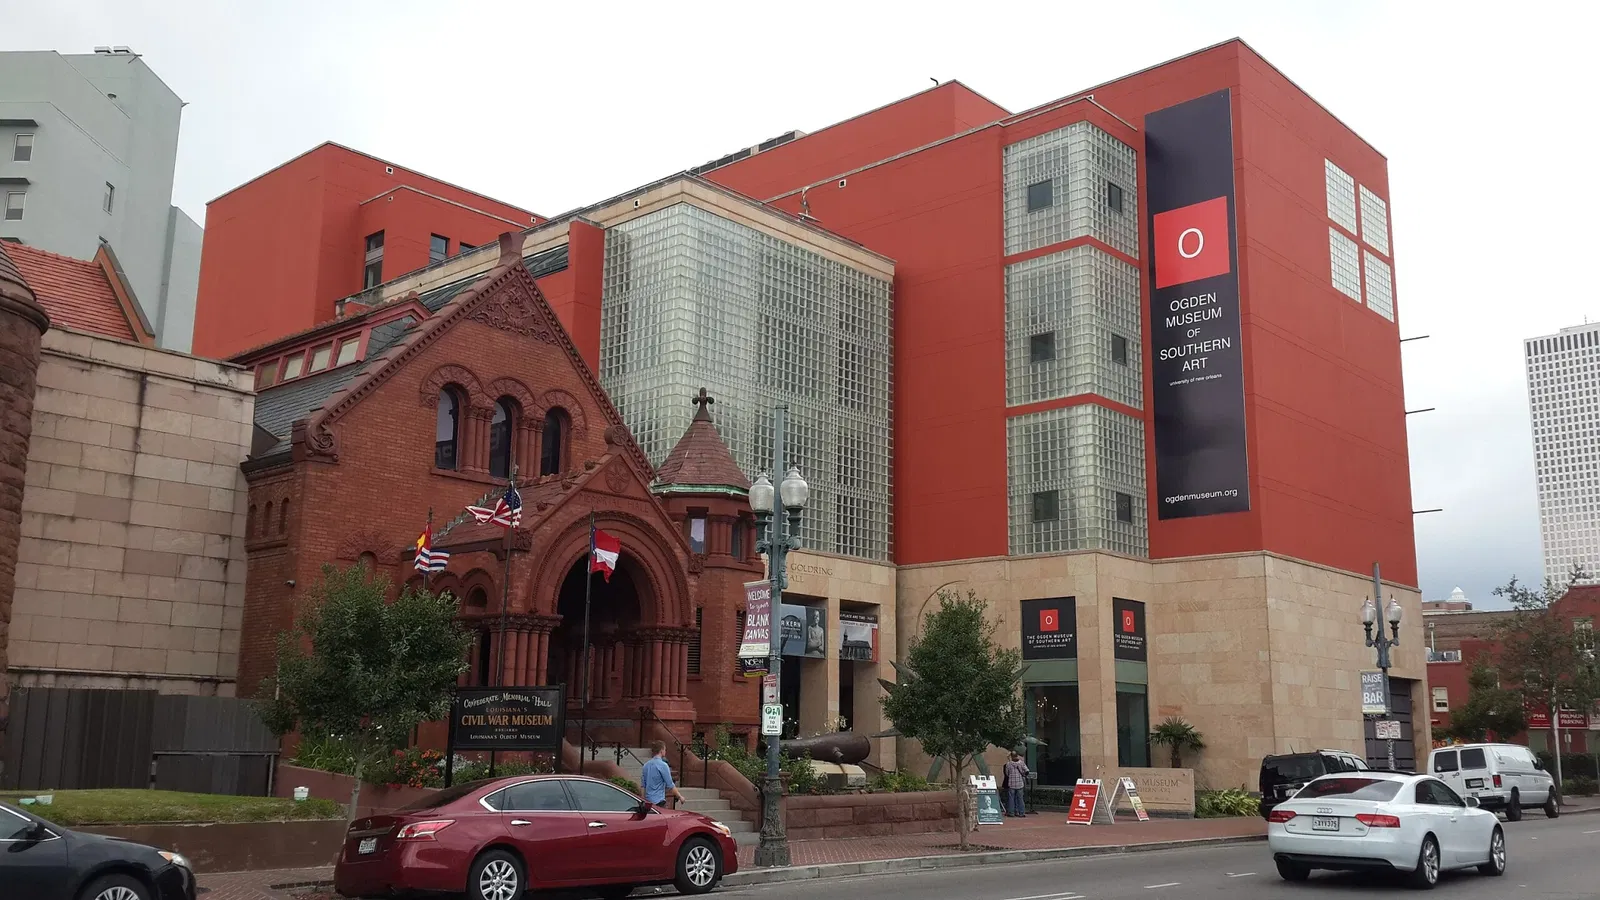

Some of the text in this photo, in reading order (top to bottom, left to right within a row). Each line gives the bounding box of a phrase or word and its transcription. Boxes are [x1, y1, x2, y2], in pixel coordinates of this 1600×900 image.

[1177, 227, 1204, 259] O
[1169, 292, 1217, 312] OGDEN
[1166, 307, 1222, 328] MUSEUM
[1187, 327, 1201, 339] OF
[1160, 337, 1231, 361] SOUTHERN
[1182, 357, 1208, 372] ART
[1165, 488, 1238, 504] ogdenmuseum.org
[628, 499, 649, 513] HALL
[790, 562, 833, 576] GOLDRING
[789, 574, 804, 583] ALL
[747, 588, 770, 601] WELCOME
[747, 613, 770, 627] BLANK
[1045, 615, 1053, 625] O
[744, 628, 769, 640] CANVAS
[1362, 673, 1382, 684] RAISE
[464, 692, 552, 708] CONFEDERATE MEMORIAL HALL
[1363, 691, 1384, 704] BAR
[462, 715, 552, 726] CIVIL WAR MUSEUM
[1142, 779, 1179, 787] MUSEUM
